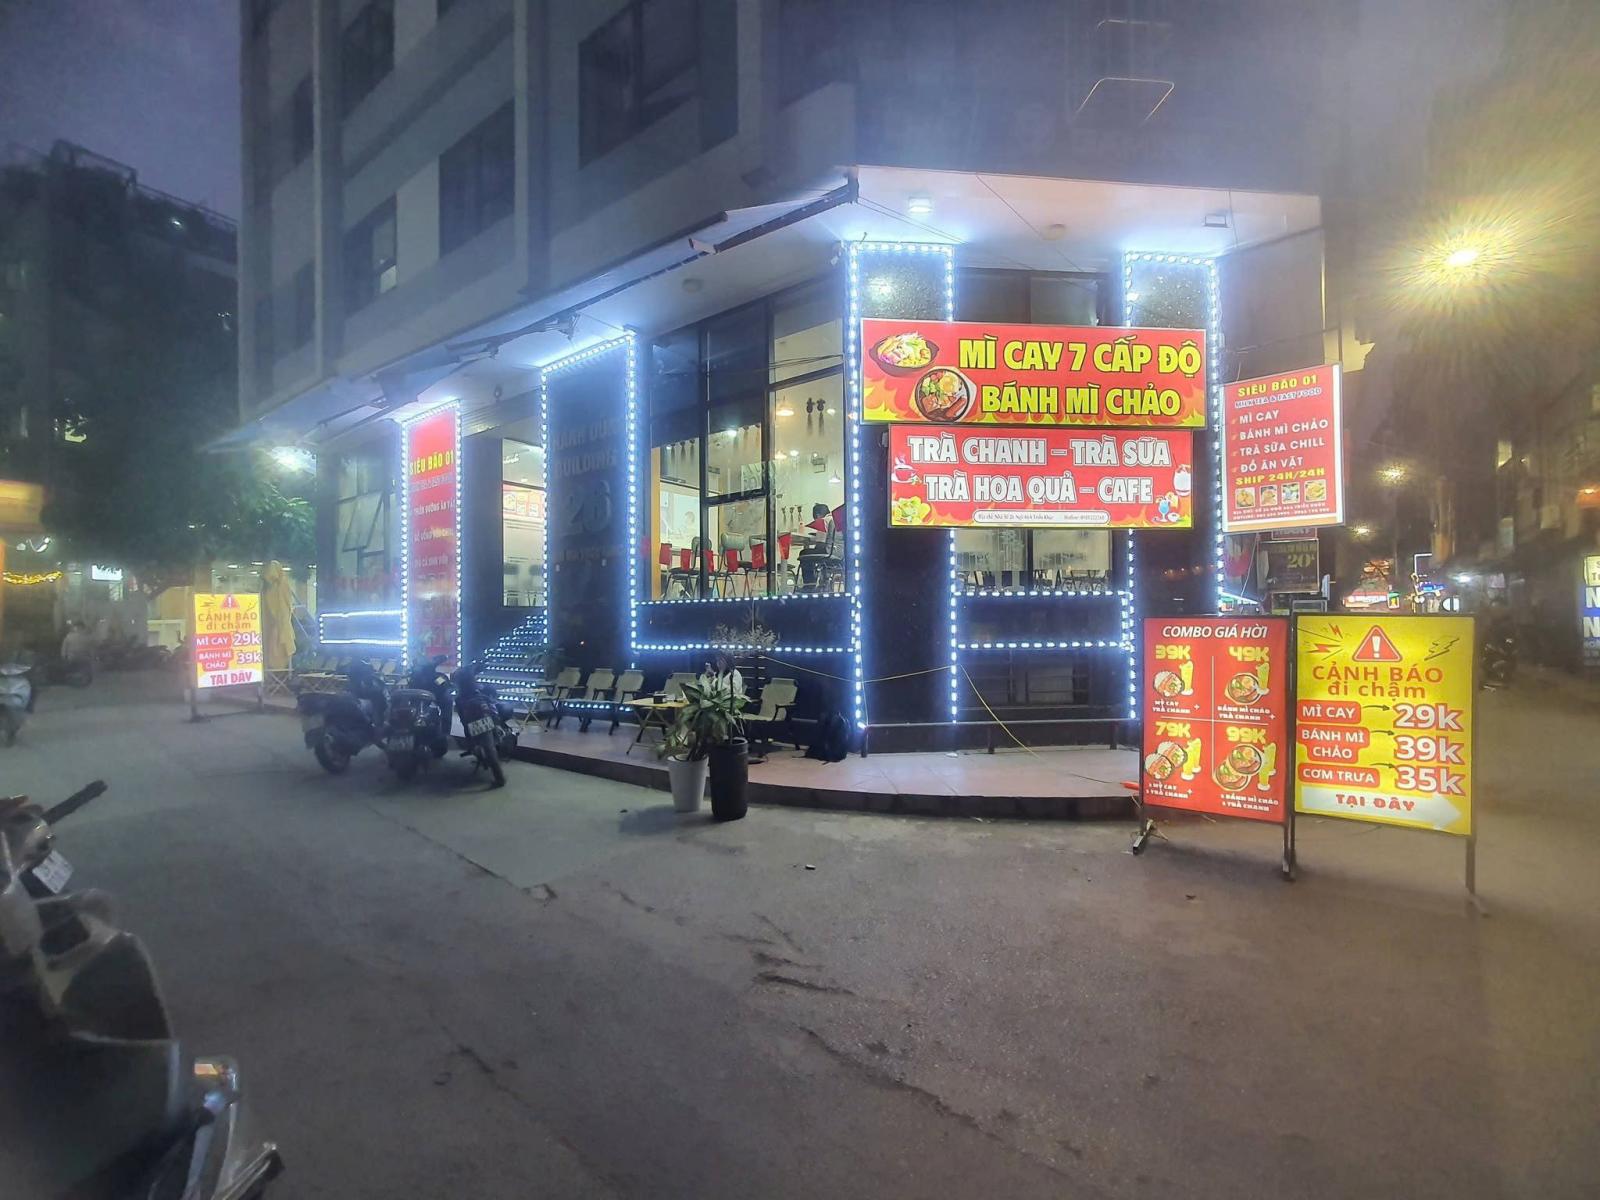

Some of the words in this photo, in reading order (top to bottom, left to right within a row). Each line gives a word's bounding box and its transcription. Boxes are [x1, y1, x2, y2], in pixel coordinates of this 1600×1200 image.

[959, 334, 997, 370] MÌ
[1003, 340, 1063, 371] CAY
[1068, 341, 1086, 371] 7
[1093, 335, 1152, 373] CẤP
[1158, 340, 1202, 378] ĐỘ
[1303, 374, 1317, 385] 01
[981, 381, 1058, 414] BÁNH
[1065, 382, 1101, 415] MÌ
[1105, 382, 1181, 416] CHẢO
[1277, 391, 1297, 401] FAST
[1297, 387, 1322, 398] FOOD
[1240, 413, 1252, 424] MÌ
[1256, 410, 1279, 422] CAY
[1240, 428, 1271, 440] BÁNH
[1274, 423, 1288, 435] MÌ
[1292, 418, 1328, 433] CHẢO
[908, 433, 958, 464] TRÀ
[963, 438, 1047, 465] CHANH
[1070, 434, 1119, 467] TRÀ
[1123, 437, 1171, 467] SỮA
[1240, 444, 1260, 456] TRÀ
[1264, 441, 1286, 454] SỮA
[1290, 437, 1325, 450] CHILL
[445, 449, 454, 465] 01
[1281, 456, 1303, 469] VẶT
[1236, 475, 1265, 485] SHIP
[1269, 468, 1325, 482] 24H/24H
[924, 471, 969, 502] TRÀ
[973, 474, 1024, 502] HOA
[1027, 471, 1077, 504] QUẢ
[1098, 477, 1153, 503] CAFE
[211, 637, 228, 645] CAY
[233, 633, 262, 646] 29k
[1163, 626, 1212, 638] COMBO
[1214, 623, 1238, 639] GIÁ
[1240, 626, 1268, 639] HỜI
[199, 651, 221, 660] BÁNH
[237, 651, 263, 664] 39k
[1155, 644, 1191, 660] 39K
[1228, 646, 1269, 662] 49K
[1312, 661, 1379, 681] CẢNH
[1389, 663, 1444, 683] BÁO
[1327, 681, 1349, 696] đi
[1358, 682, 1426, 702] chậm
[1217, 704, 1238, 712] BÁNH
[1302, 704, 1322, 718] MÌ
[1326, 706, 1356, 719] CAY
[1393, 703, 1464, 731] 29k
[1155, 722, 1191, 738] 79K
[1226, 727, 1266, 744] 99K
[1301, 728, 1341, 742] BÁNH
[1345, 730, 1365, 743] MÌ
[1394, 735, 1465, 765] 39k
[1312, 746, 1353, 760] CHẢO
[1302, 768, 1333, 780] CƠM
[1336, 770, 1376, 784] TRƯA
[1395, 765, 1466, 796] 35k
[1336, 793, 1366, 808] TẠI
[1373, 796, 1415, 811] ĐÂY
